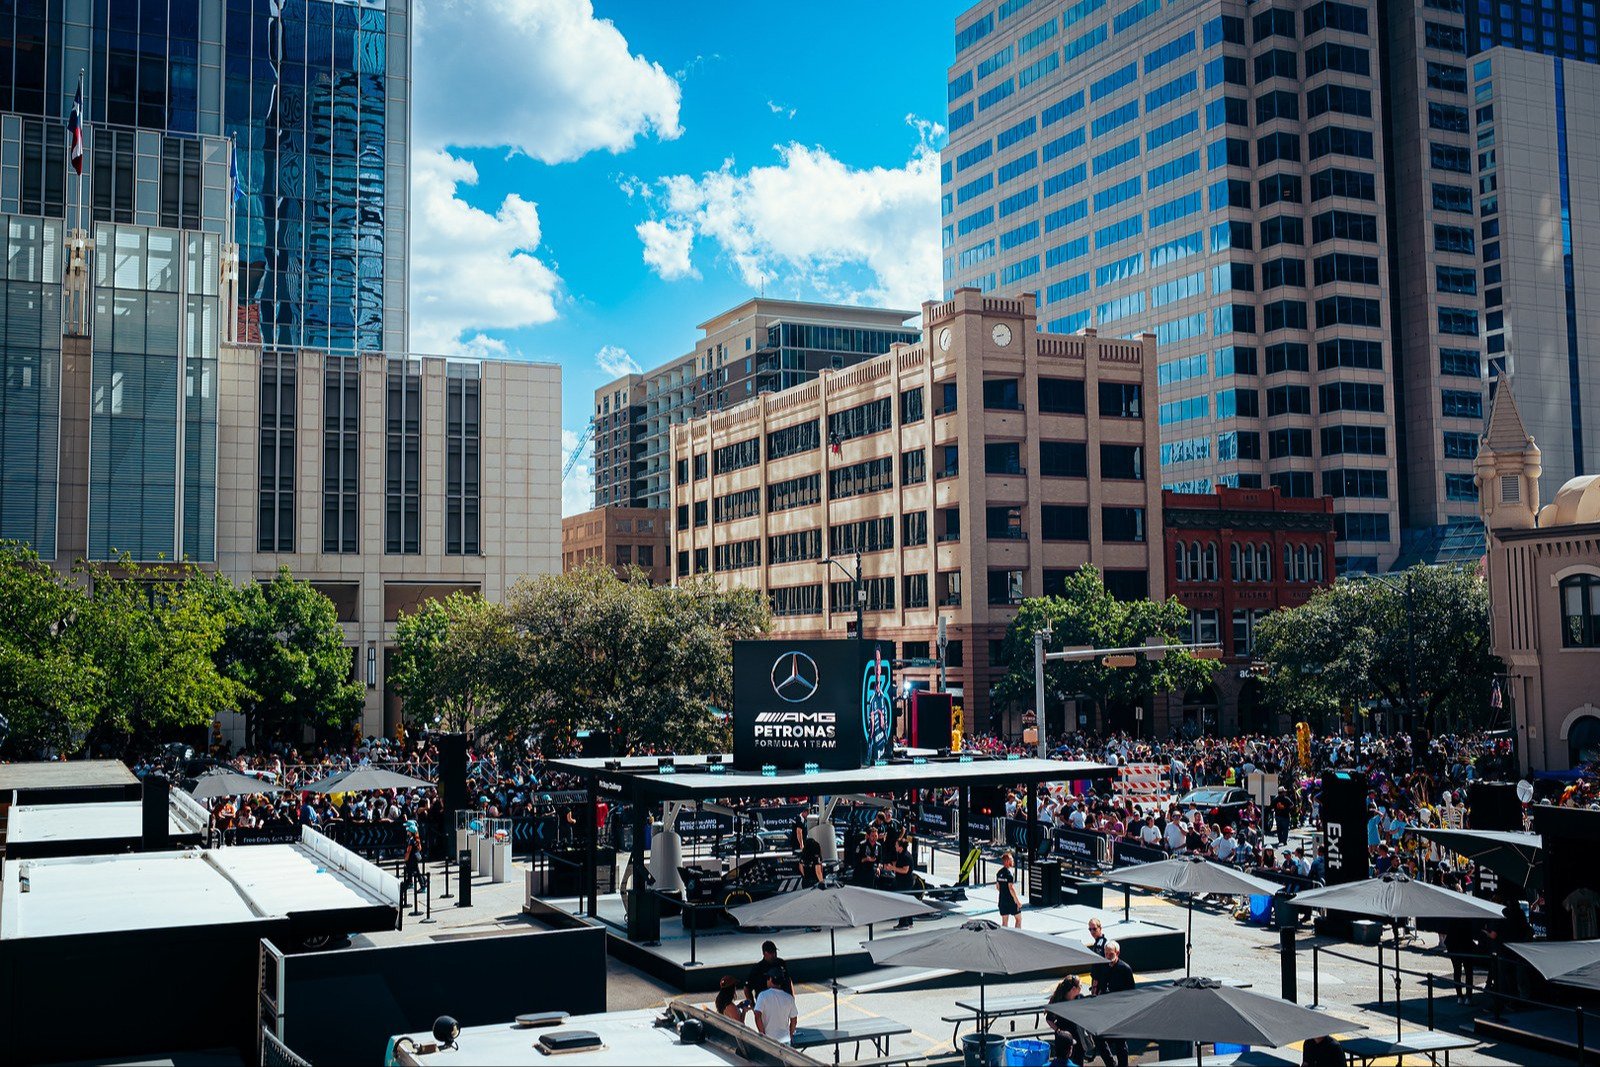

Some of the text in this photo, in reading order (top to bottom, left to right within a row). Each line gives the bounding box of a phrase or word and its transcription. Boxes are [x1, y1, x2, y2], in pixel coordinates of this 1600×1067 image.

[780, 712, 836, 723] AMG
[753, 725, 836, 738] PETRONAS
[754, 739, 837, 748] FORMULA 1 TEAM
[1327, 822, 1343, 870] Exit
